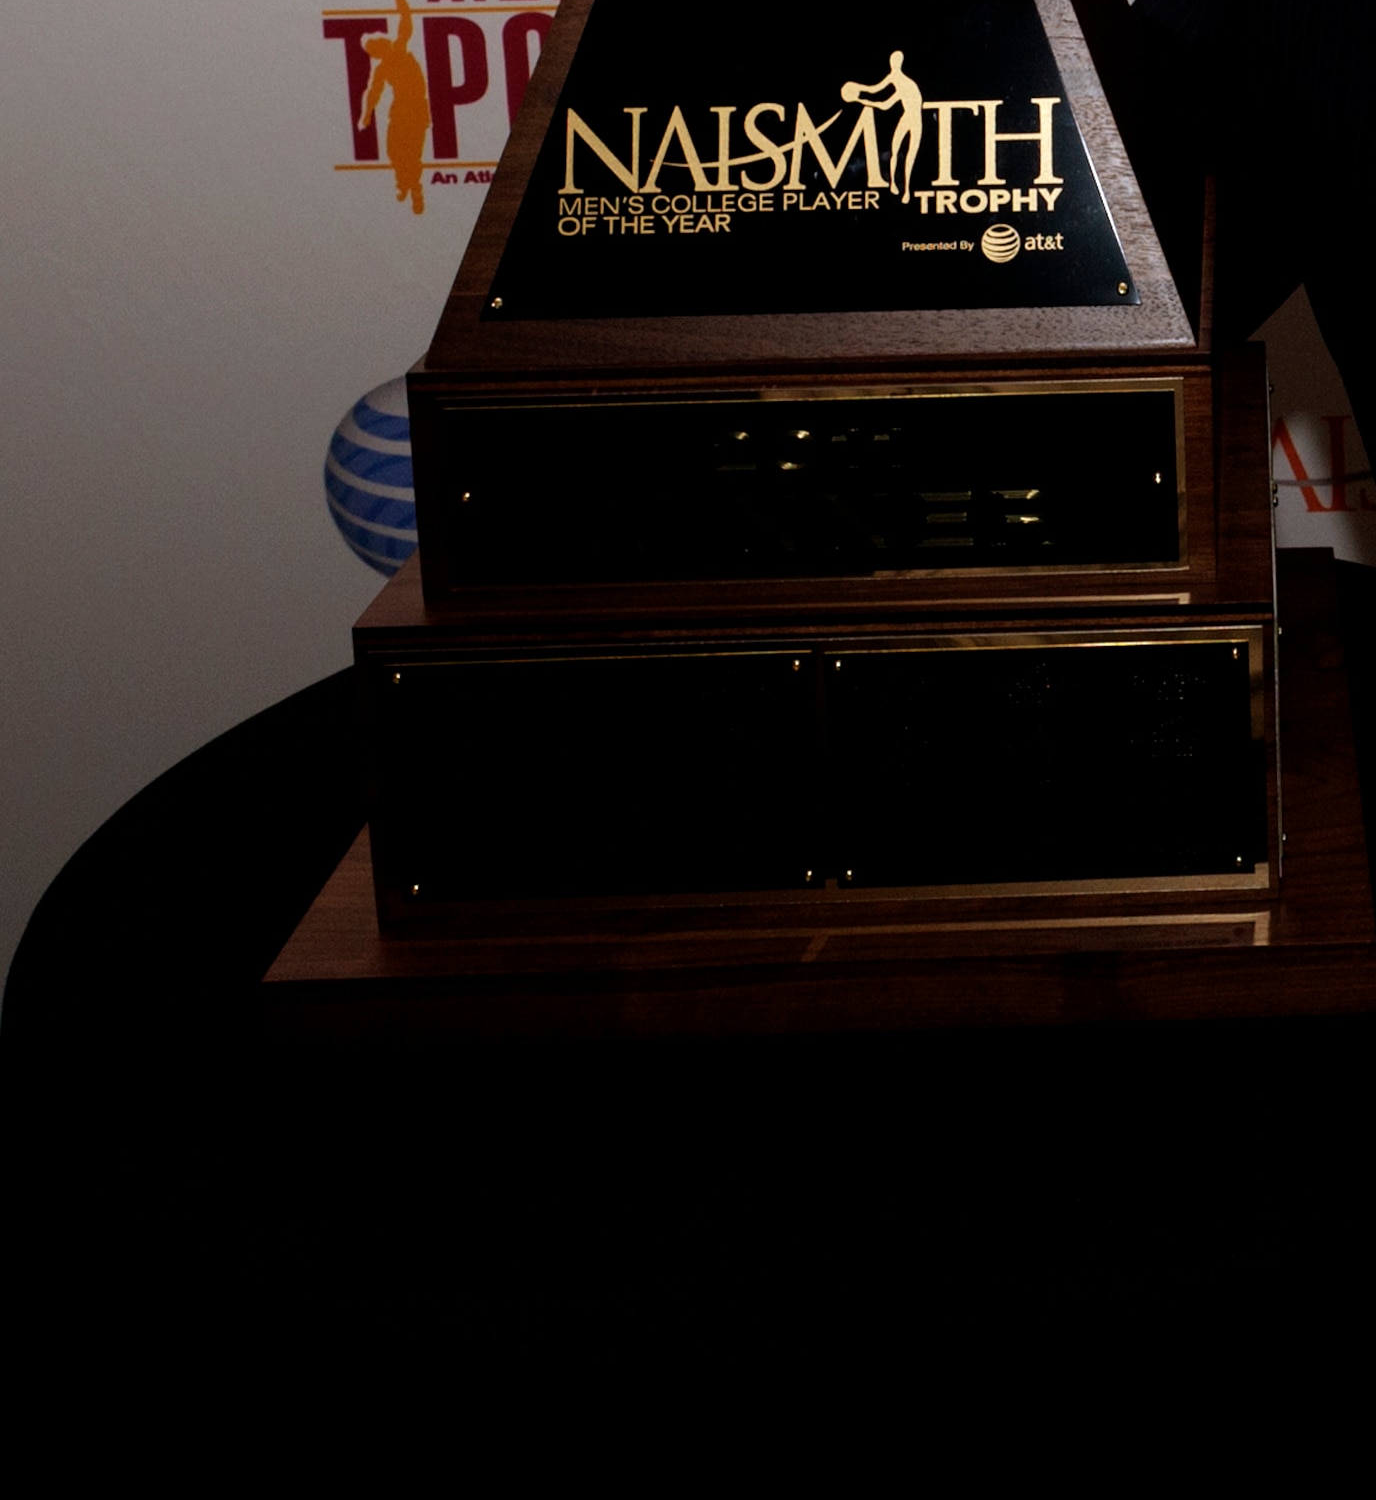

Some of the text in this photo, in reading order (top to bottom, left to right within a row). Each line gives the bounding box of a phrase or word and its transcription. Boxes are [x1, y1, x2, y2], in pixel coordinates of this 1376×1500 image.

[557, 82, 1064, 200] NAISMITH
[431, 171, 458, 185] An
[558, 190, 880, 216] MEN'S COLLEGE PLAYER
[914, 187, 1063, 214] TROPHY
[557, 213, 731, 236] OF THE YEAR
[902, 240, 975, 252] Presented By
[1024, 232, 1064, 251] at&t
